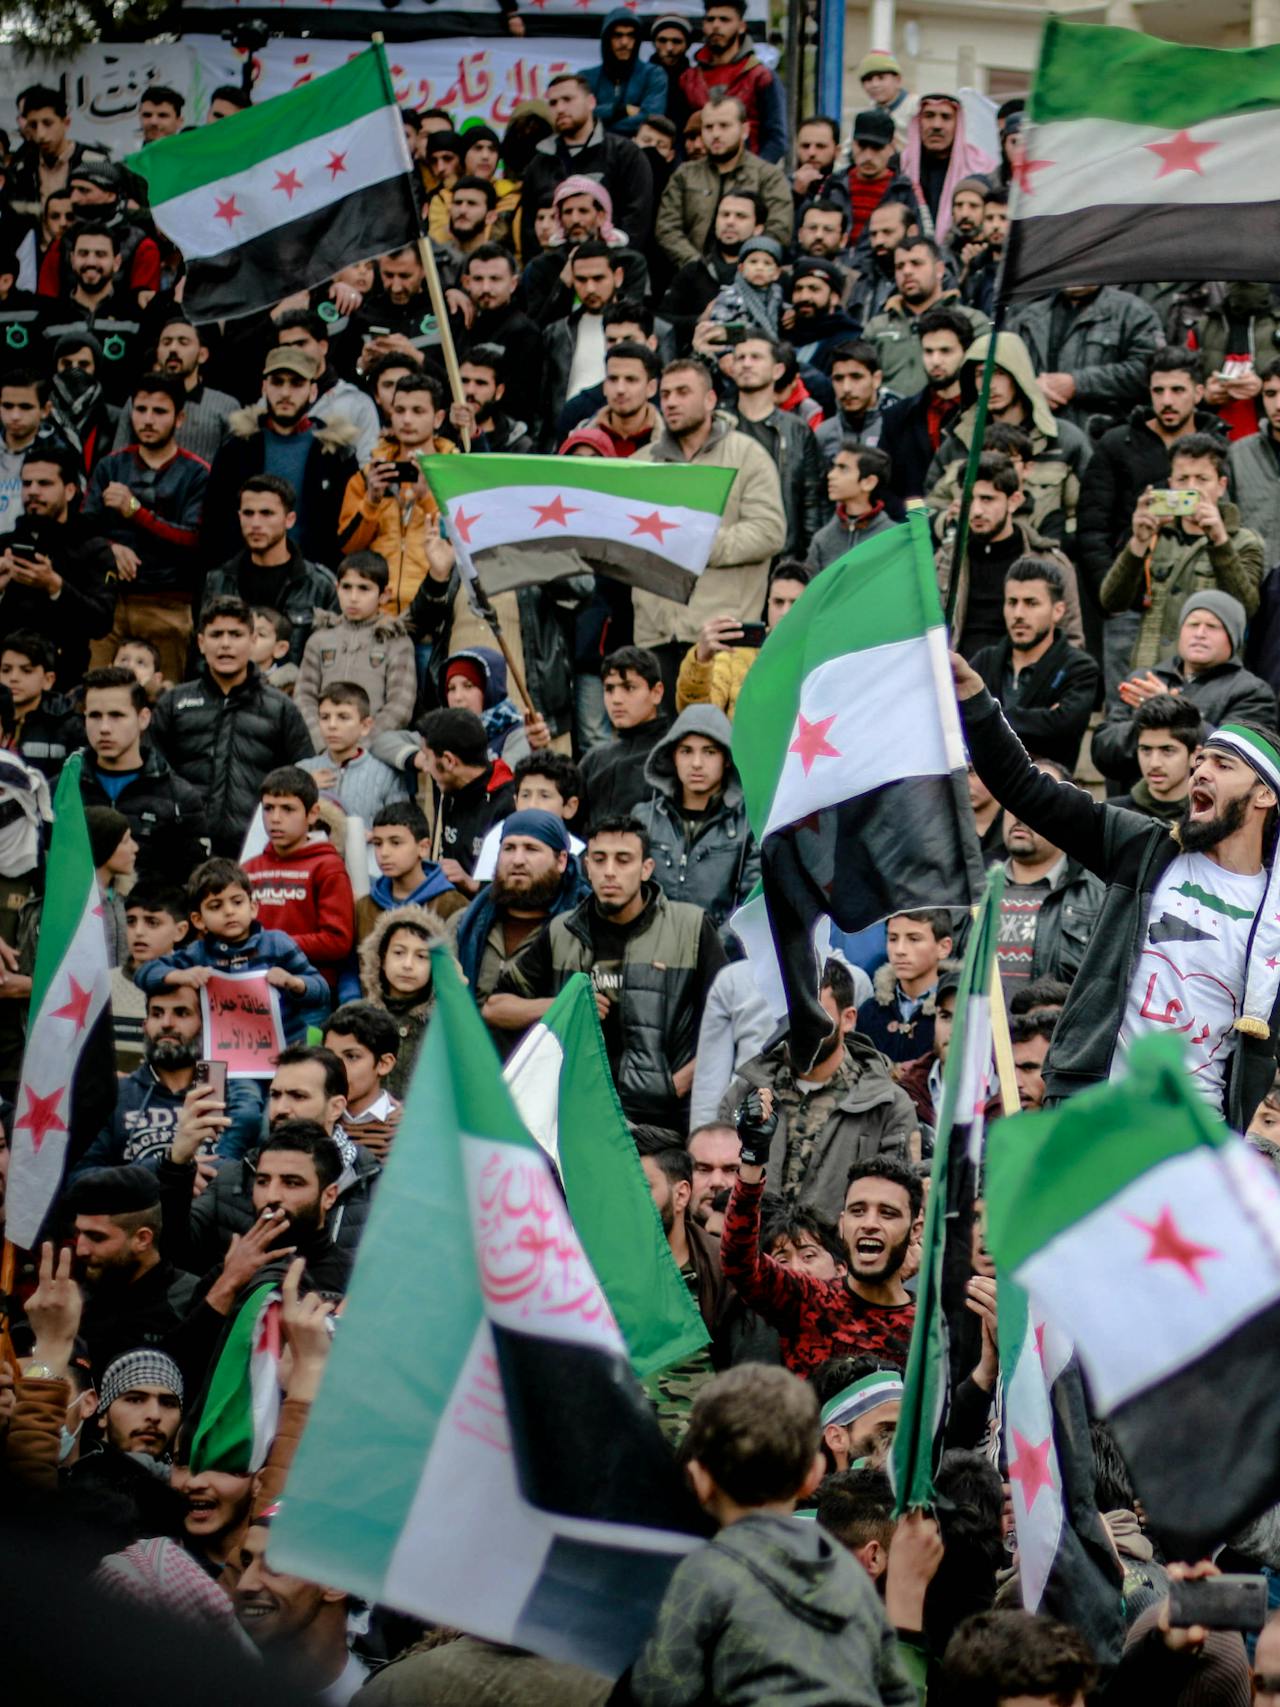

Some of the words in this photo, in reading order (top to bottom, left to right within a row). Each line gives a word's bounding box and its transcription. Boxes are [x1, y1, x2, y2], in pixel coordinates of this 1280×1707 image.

[210, 991, 238, 1017] حمراء
[240, 993, 271, 1020] بطاقة
[1139, 972, 1210, 1045] درعا
